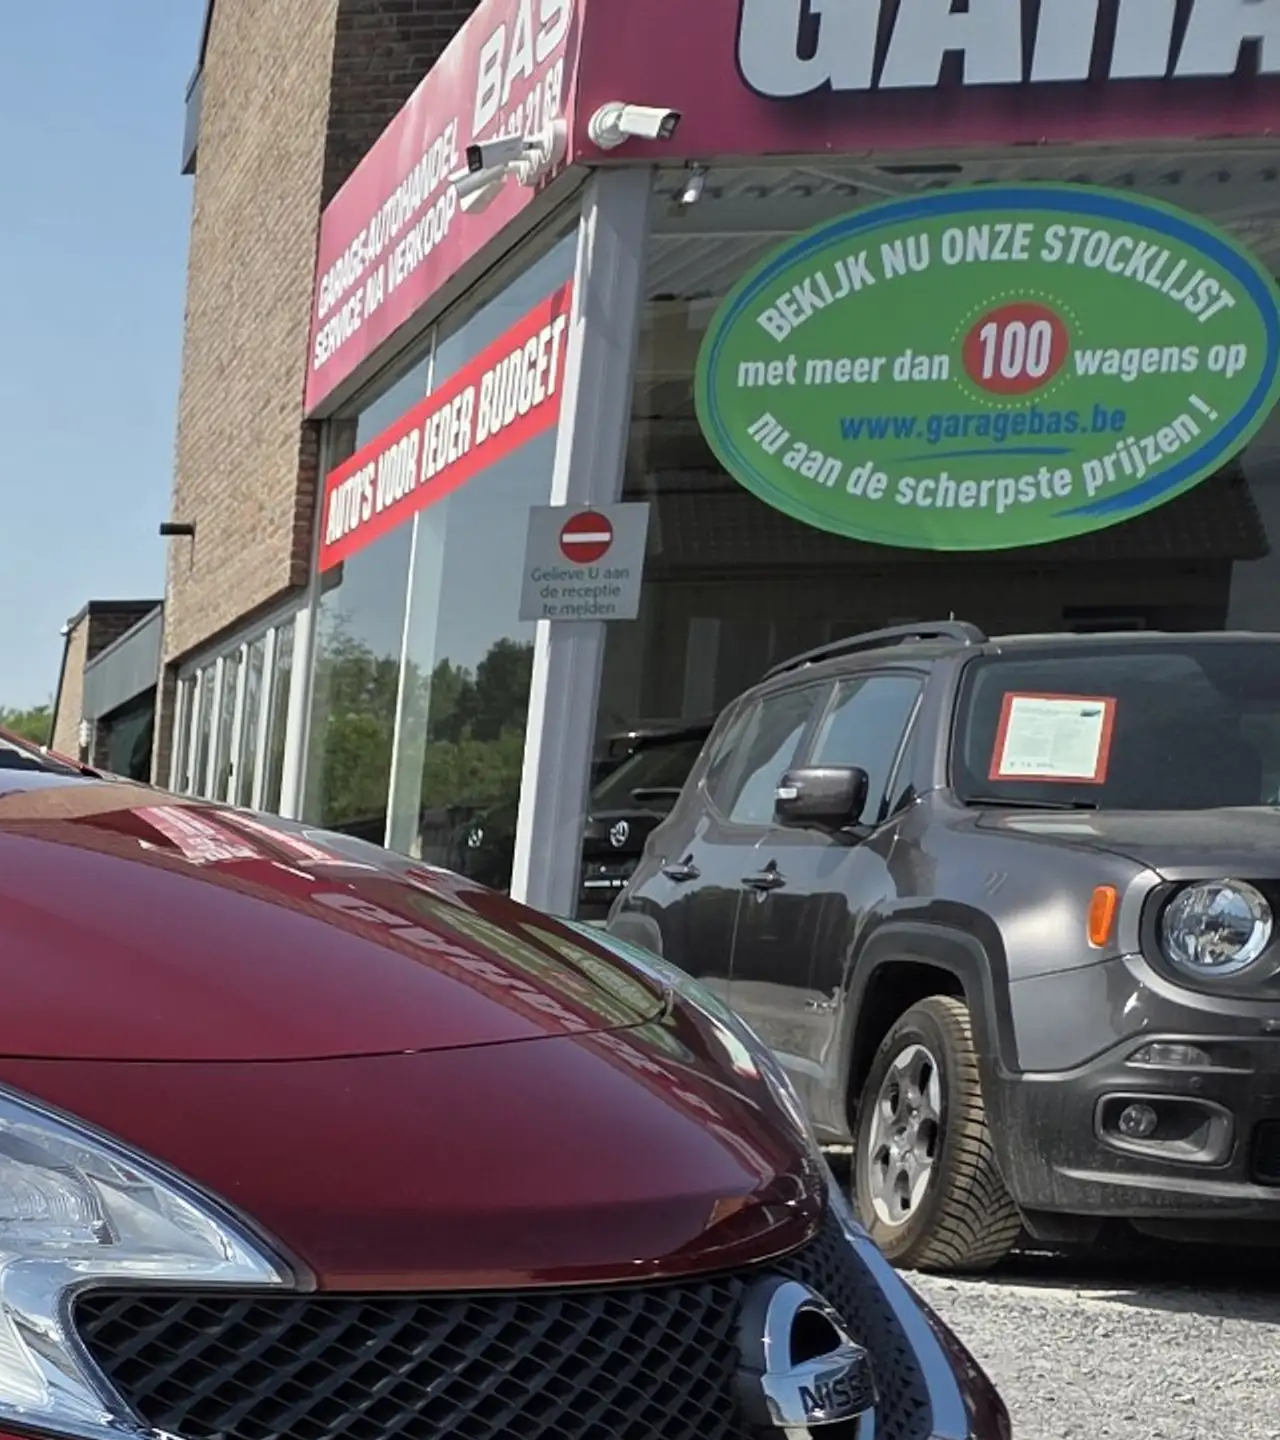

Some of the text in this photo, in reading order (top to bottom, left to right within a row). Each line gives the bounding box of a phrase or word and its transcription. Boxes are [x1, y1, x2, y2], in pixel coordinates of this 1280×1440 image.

[388, 184, 457, 293] VERKOOP
[756, 223, 1236, 342] BEKIJK NU ONZE STOCKLIJST
[737, 320, 1247, 387] met meer dan 100 wagens op
[325, 314, 567, 546] AUTO'S VOOR IEDER BUDGET
[747, 394, 1219, 514] nu aan de scherpste prijzen !
[840, 403, 1127, 443] www.garagebas.be
[531, 566, 630, 582] Gelieve U aan
[540, 583, 622, 604] de receptie
[543, 602, 616, 615] te melden
